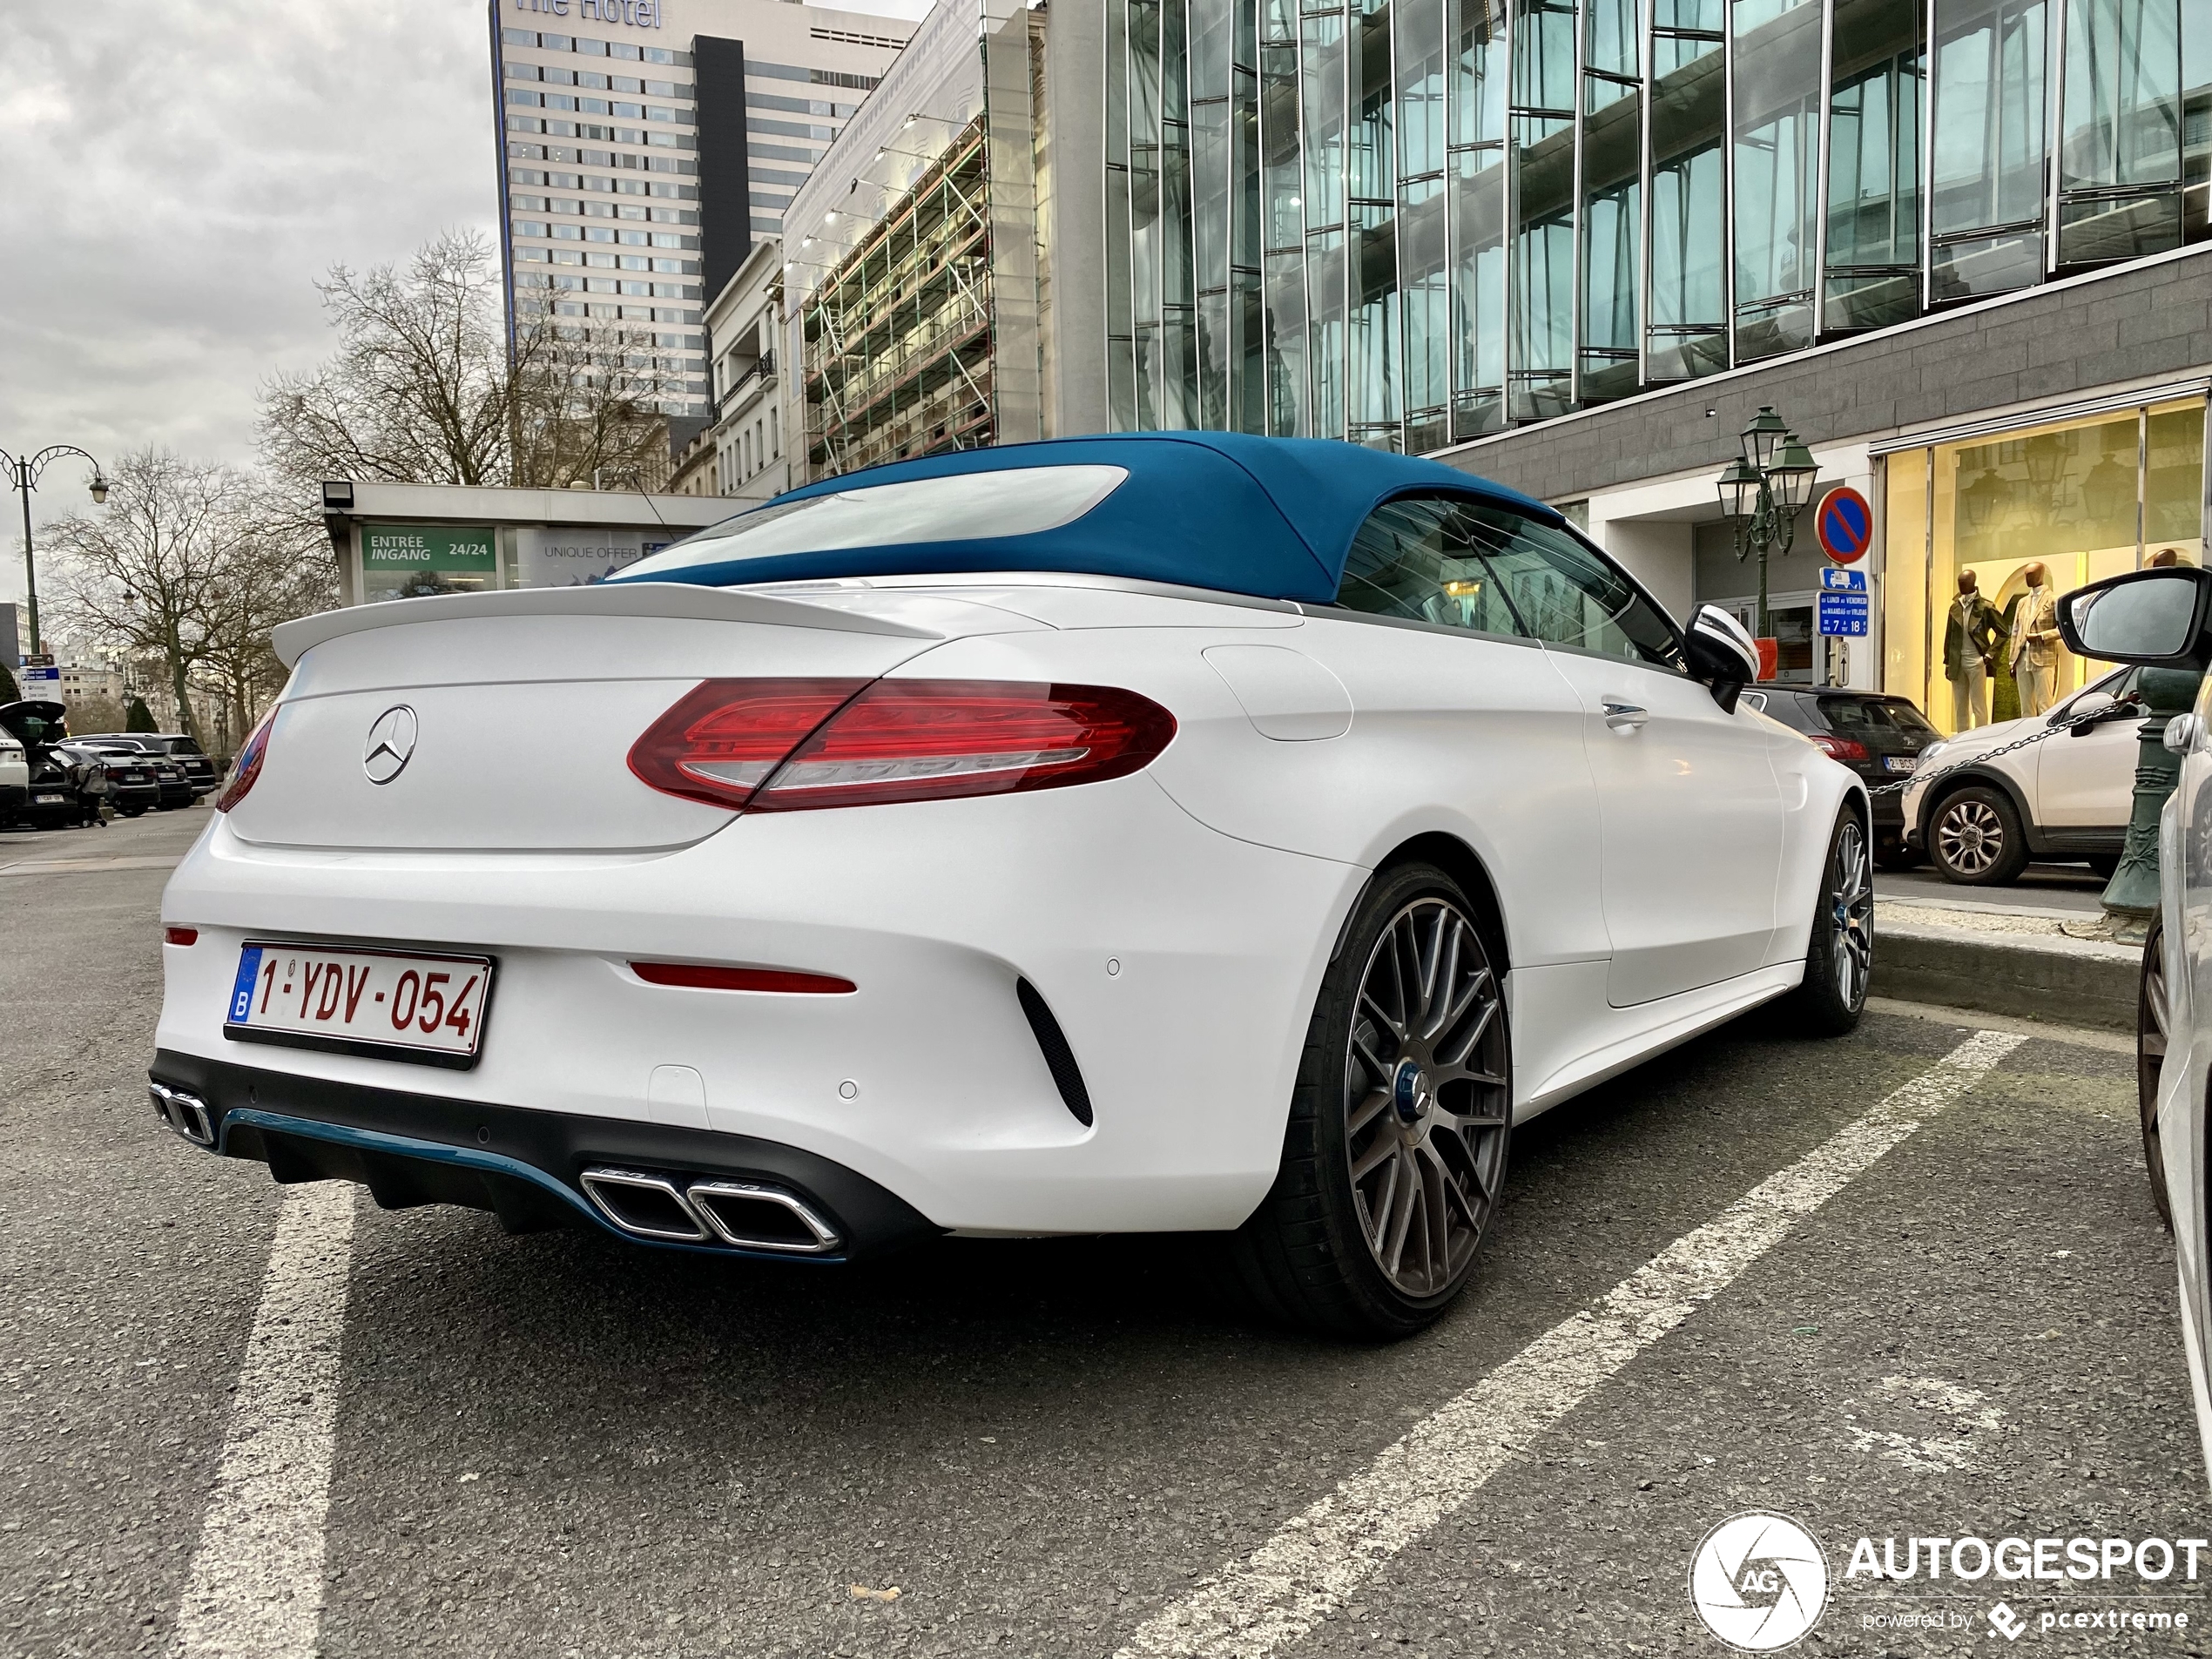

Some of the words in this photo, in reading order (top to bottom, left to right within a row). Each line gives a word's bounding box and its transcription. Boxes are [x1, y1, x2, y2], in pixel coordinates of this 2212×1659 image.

[371, 534, 424, 548] ENTRÉE
[371, 549, 431, 561] INGANG
[448, 543, 488, 556] 24/24
[544, 547, 593, 558] UNIQUE
[597, 547, 637, 559] OFFER
[1833, 619, 1839, 631] 7
[1851, 620, 1860, 632] 18
[234, 991, 249, 1016] B
[260, 959, 478, 1036] 1-YDV-054
